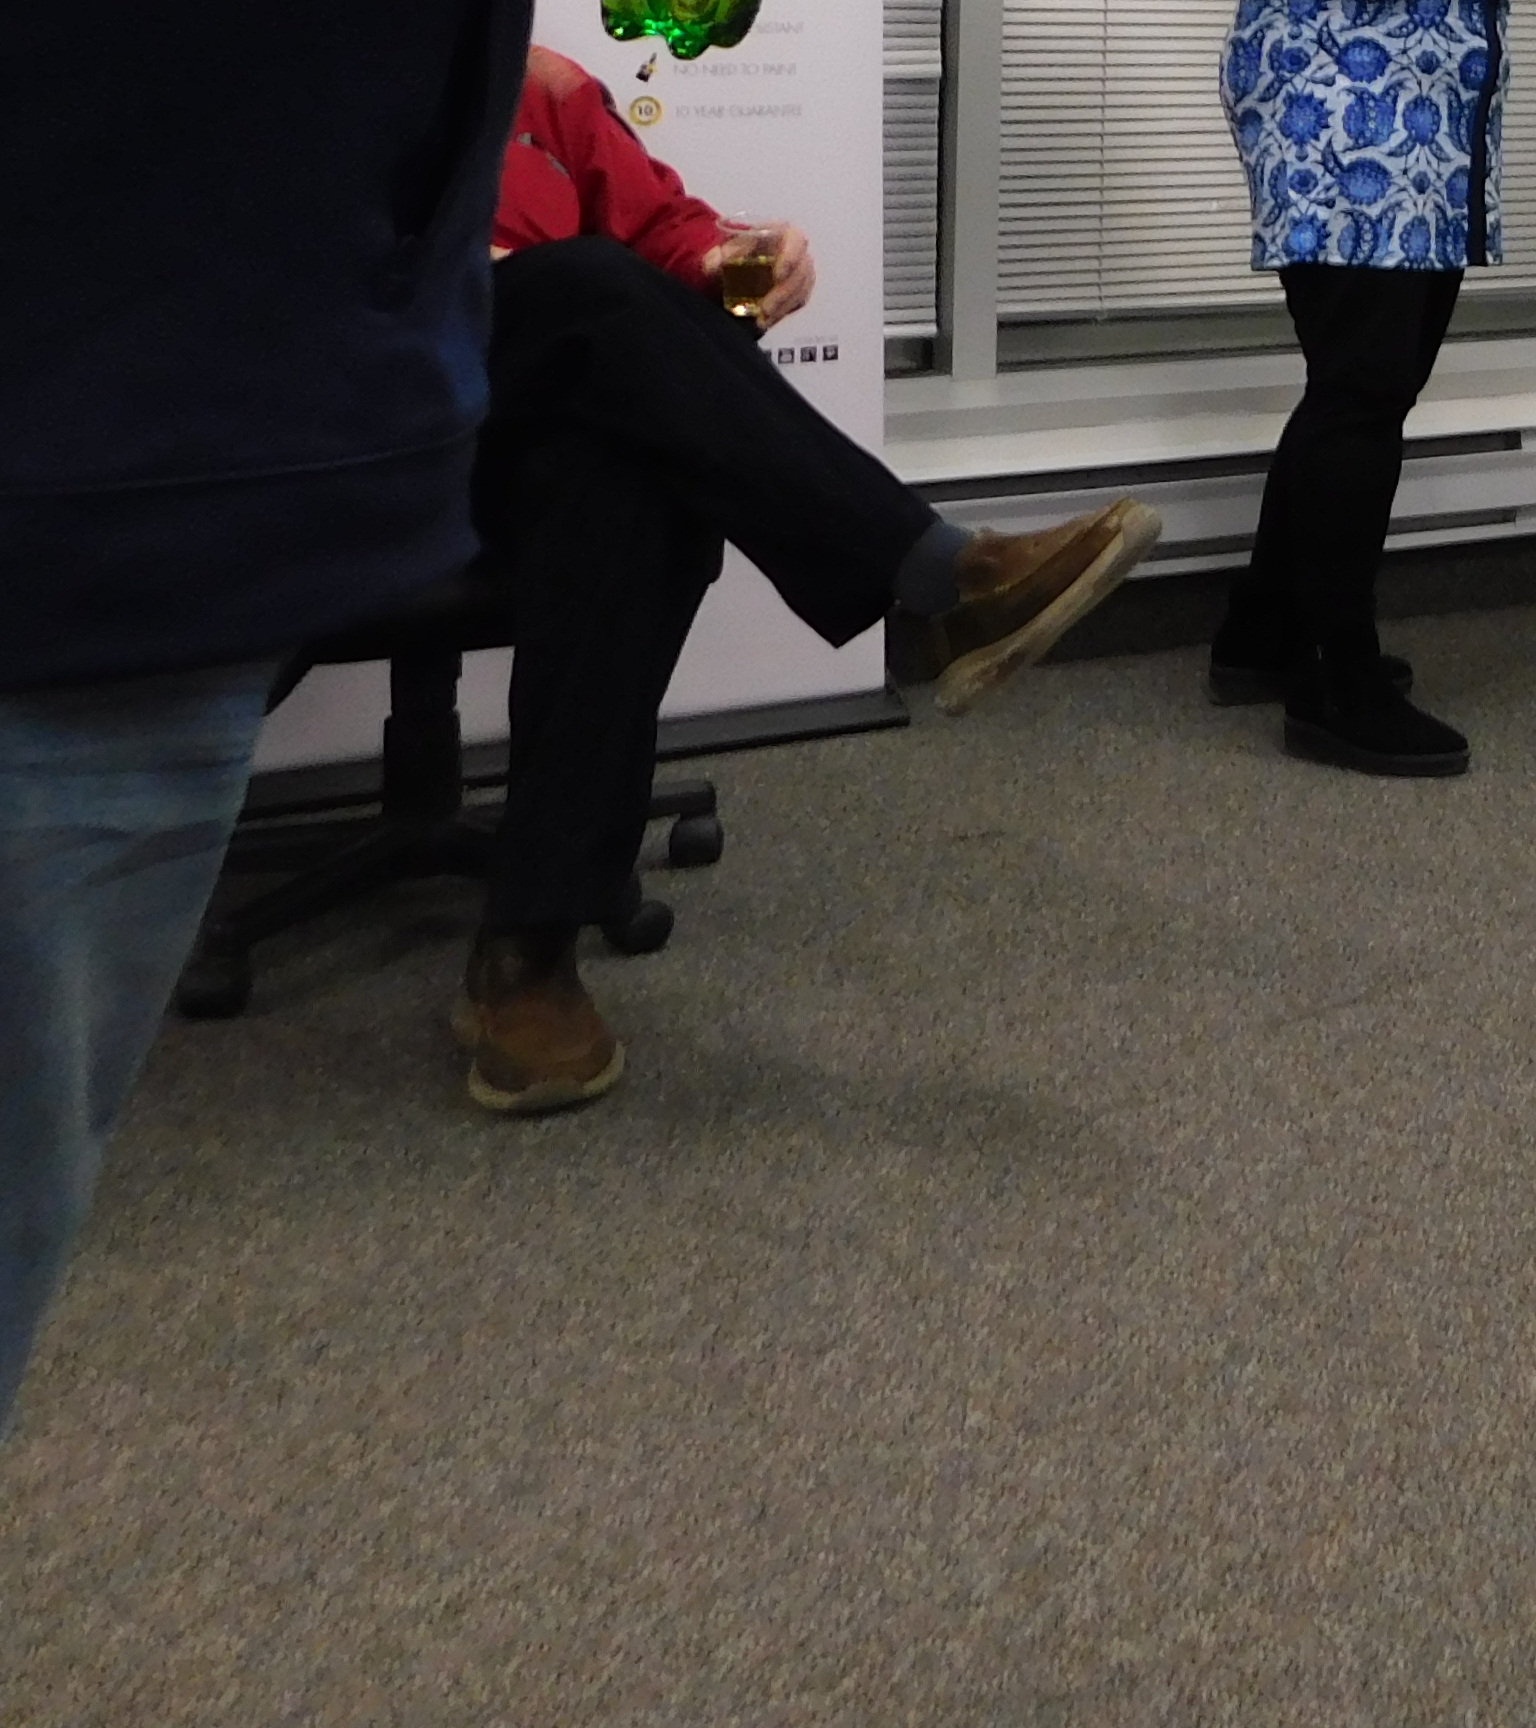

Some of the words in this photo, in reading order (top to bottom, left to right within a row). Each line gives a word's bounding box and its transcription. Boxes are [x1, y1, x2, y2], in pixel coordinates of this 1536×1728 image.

[674, 63, 698, 76] NO
[702, 63, 737, 76] NEED
[742, 63, 759, 76] TO
[637, 105, 653, 117] 10
[693, 104, 724, 117] YEAR
